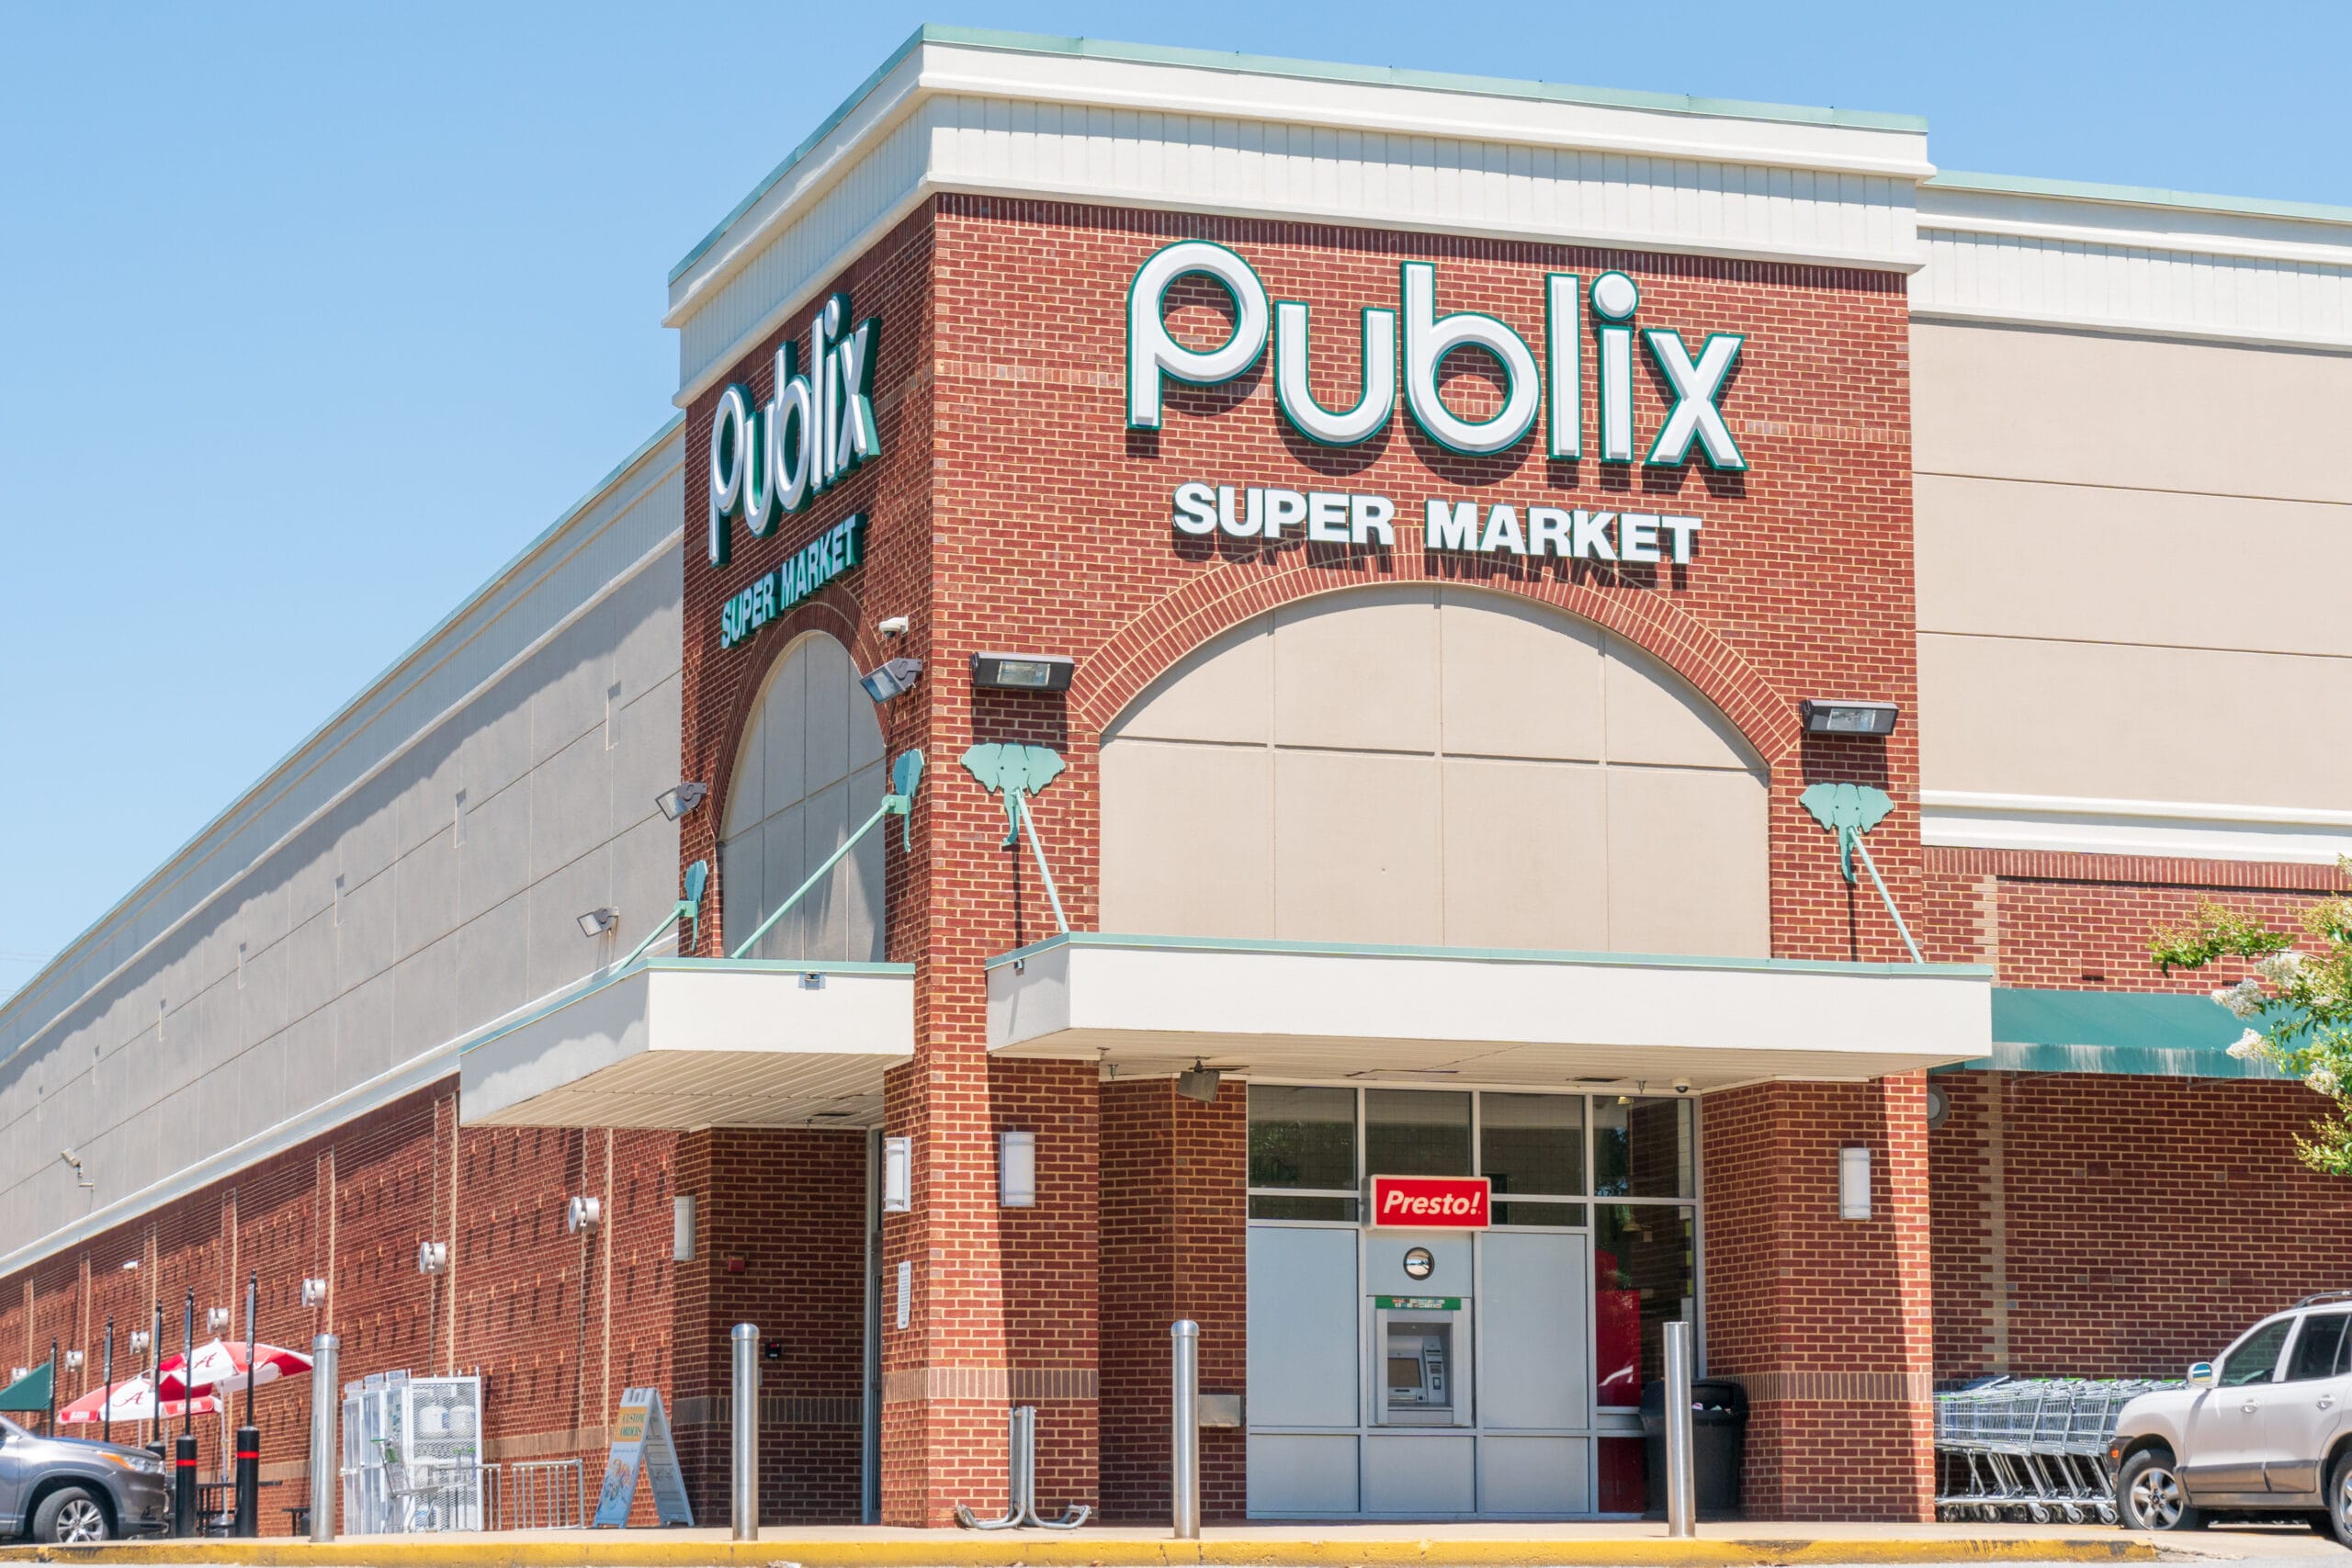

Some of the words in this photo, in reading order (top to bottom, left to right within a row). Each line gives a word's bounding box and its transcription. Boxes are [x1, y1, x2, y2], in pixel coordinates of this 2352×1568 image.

[1127, 240, 1748, 470] Publix
[708, 293, 881, 568] Publix
[721, 572, 778, 649] SUPER
[781, 513, 864, 610] MARKET
[1171, 480, 1395, 546] SUPER
[1424, 499, 1702, 564] MARKET
[1383, 1190, 1481, 1215] Presto!
